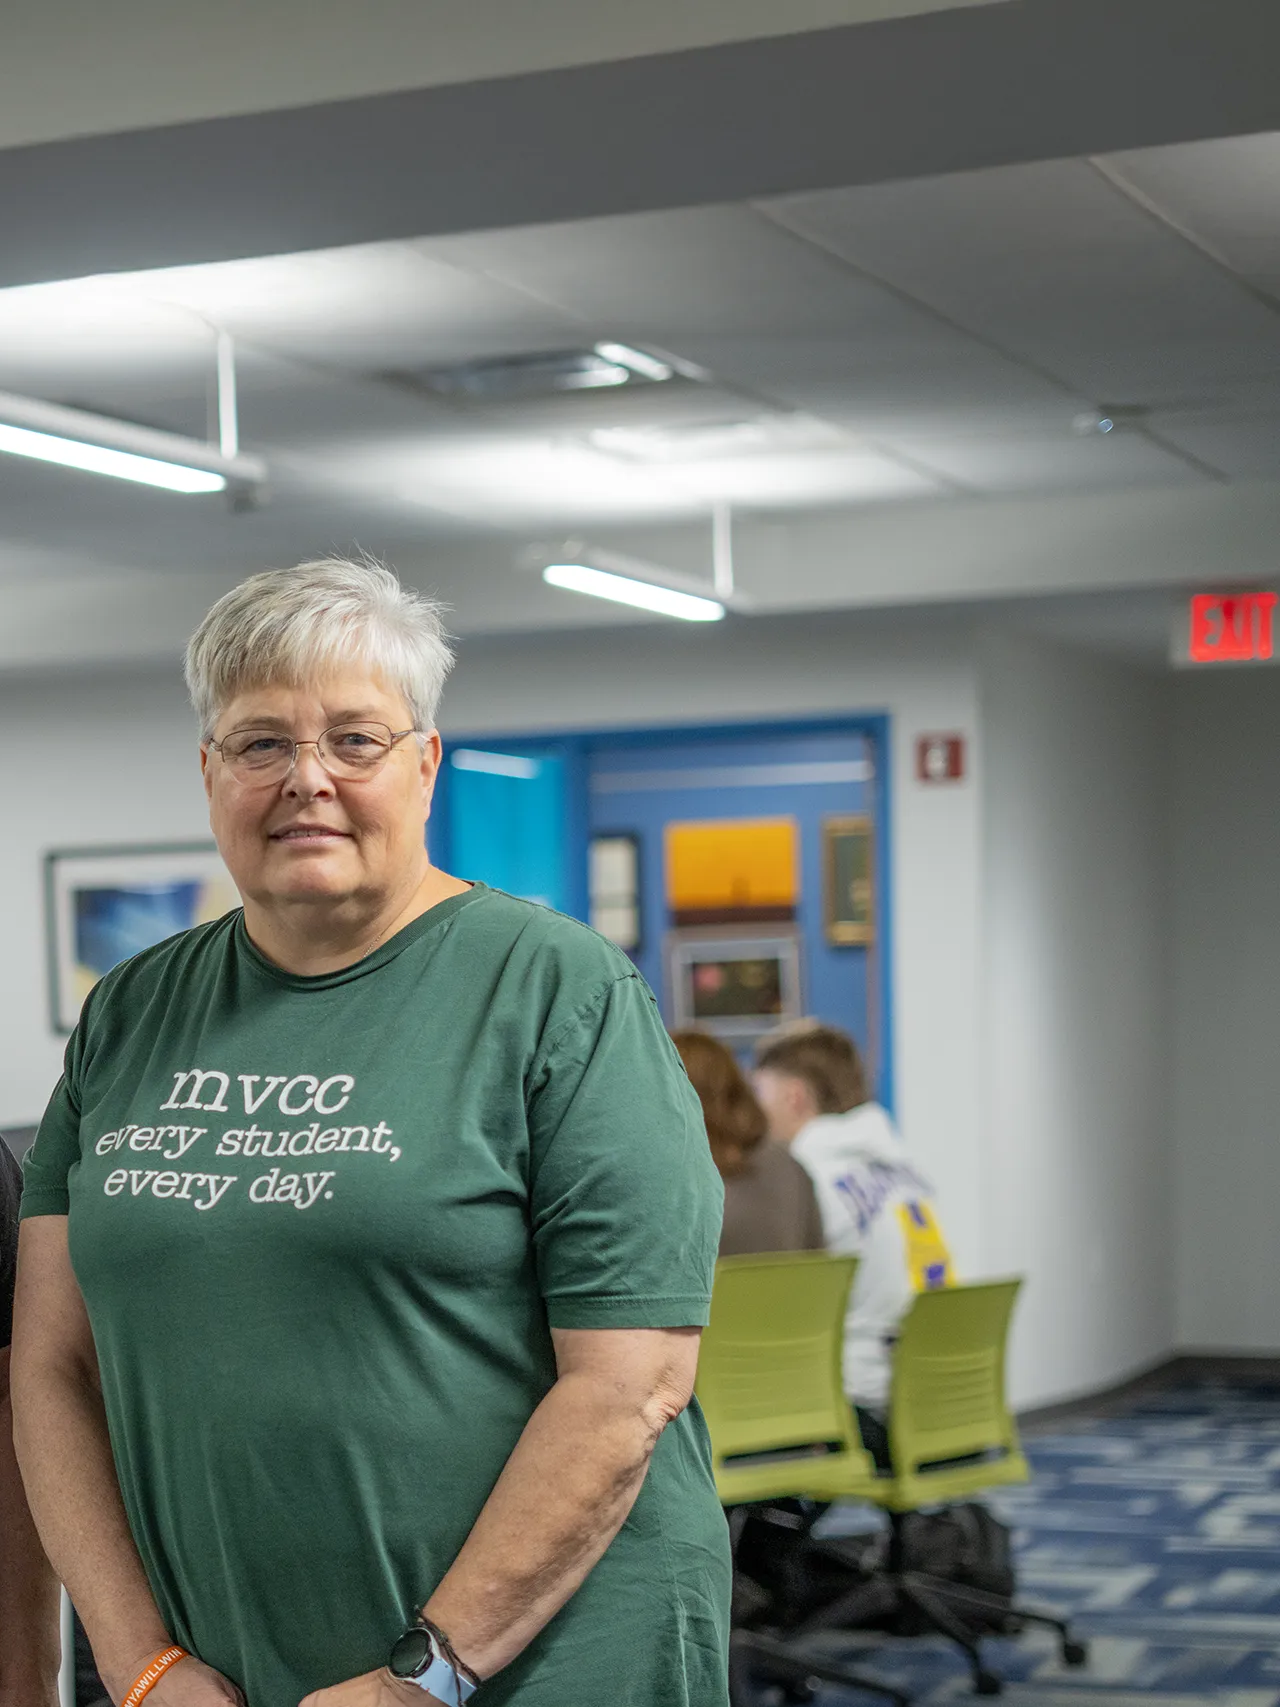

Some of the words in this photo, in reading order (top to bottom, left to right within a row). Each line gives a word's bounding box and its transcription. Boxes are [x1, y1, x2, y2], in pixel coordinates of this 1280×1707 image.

[1190, 591, 1278, 662] EXIT
[159, 1068, 355, 1116] mvcc
[95, 1124, 207, 1159] every
[215, 1121, 402, 1162] student,
[103, 1168, 237, 1210] every
[249, 1168, 336, 1210] day.
